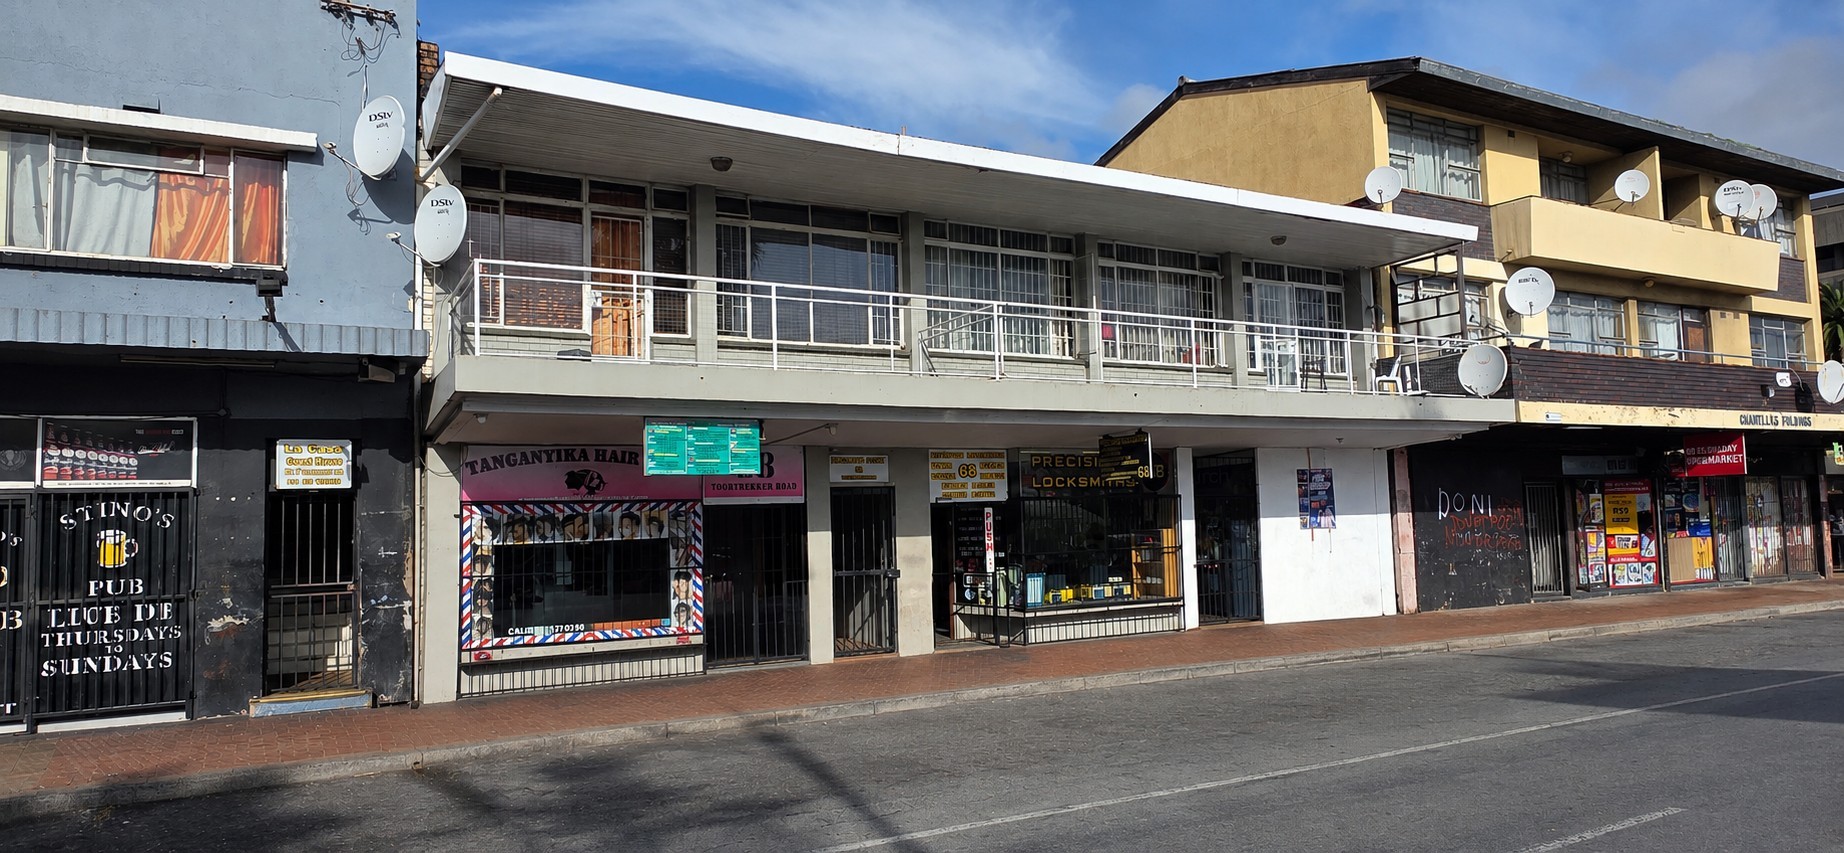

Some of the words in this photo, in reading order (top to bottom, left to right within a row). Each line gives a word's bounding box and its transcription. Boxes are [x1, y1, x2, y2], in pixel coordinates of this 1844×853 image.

[465, 448, 590, 476] TANGANYIKA
[594, 449, 640, 466] HAIR
[957, 463, 977, 478] 68
[1031, 456, 1100, 467] PRECISI
[1137, 465, 1150, 478] 68
[60, 501, 174, 530] STINO'S
[88, 578, 144, 597] PUB
[41, 625, 182, 648] THURSDAYS
[41, 651, 173, 677] SUNDAYS
